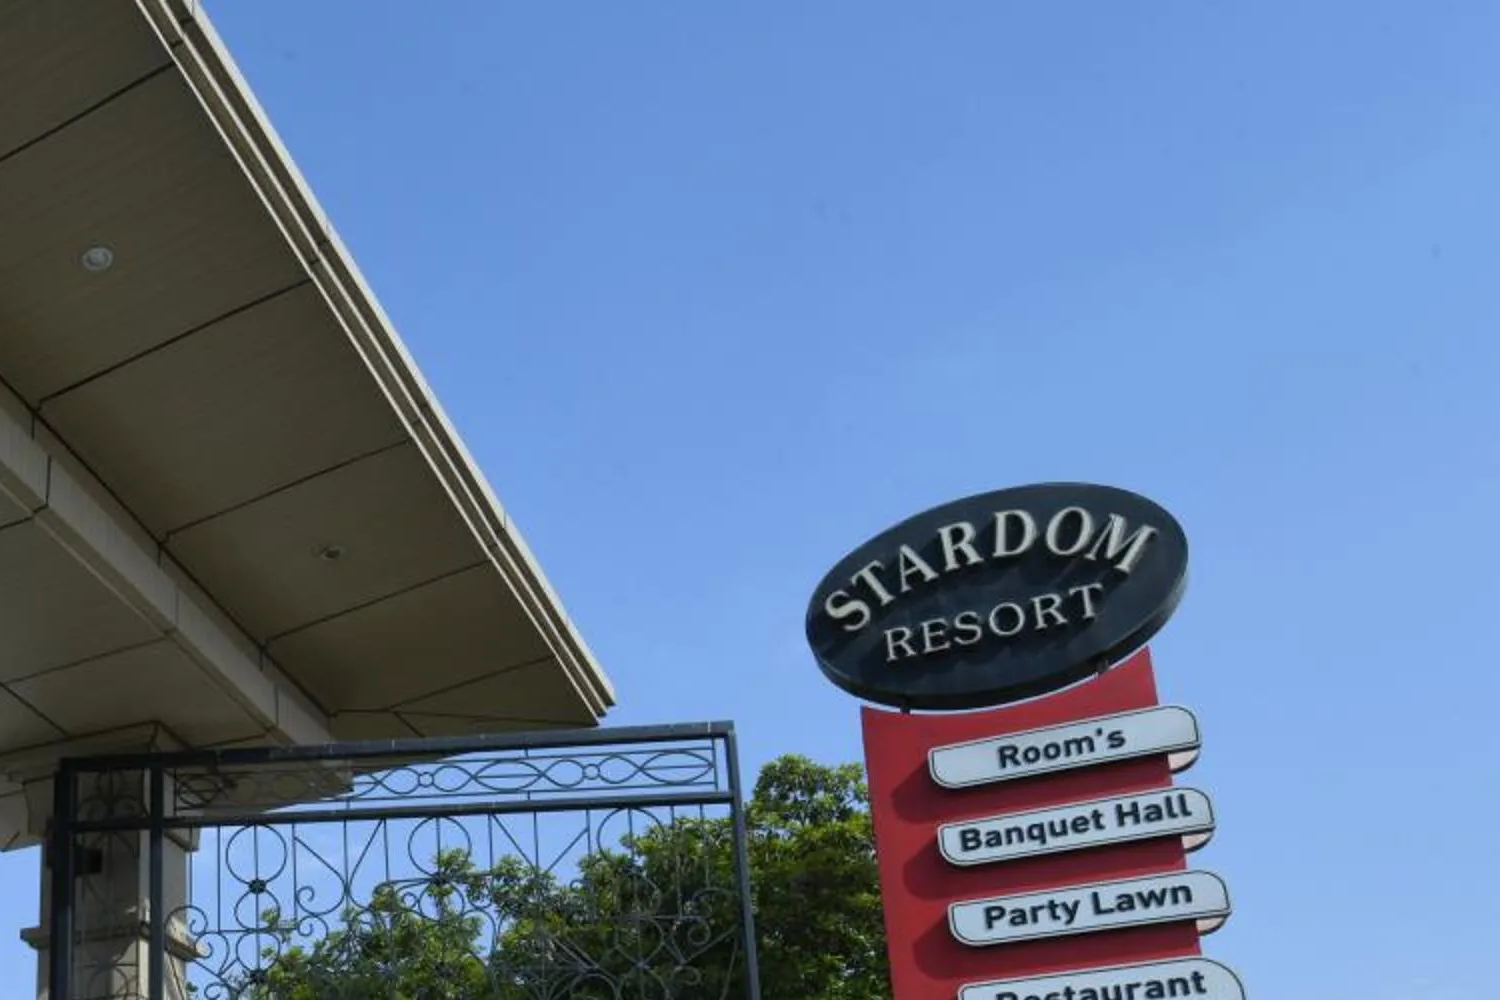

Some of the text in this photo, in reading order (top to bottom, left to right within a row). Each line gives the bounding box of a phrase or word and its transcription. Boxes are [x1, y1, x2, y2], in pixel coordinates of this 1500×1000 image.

[825, 506, 1156, 632] STARDOM
[884, 582, 1104, 662] RESORT
[996, 726, 1127, 770] Room's
[959, 793, 1193, 852] Banquet Hall
[983, 884, 1194, 930] Party Lawn
